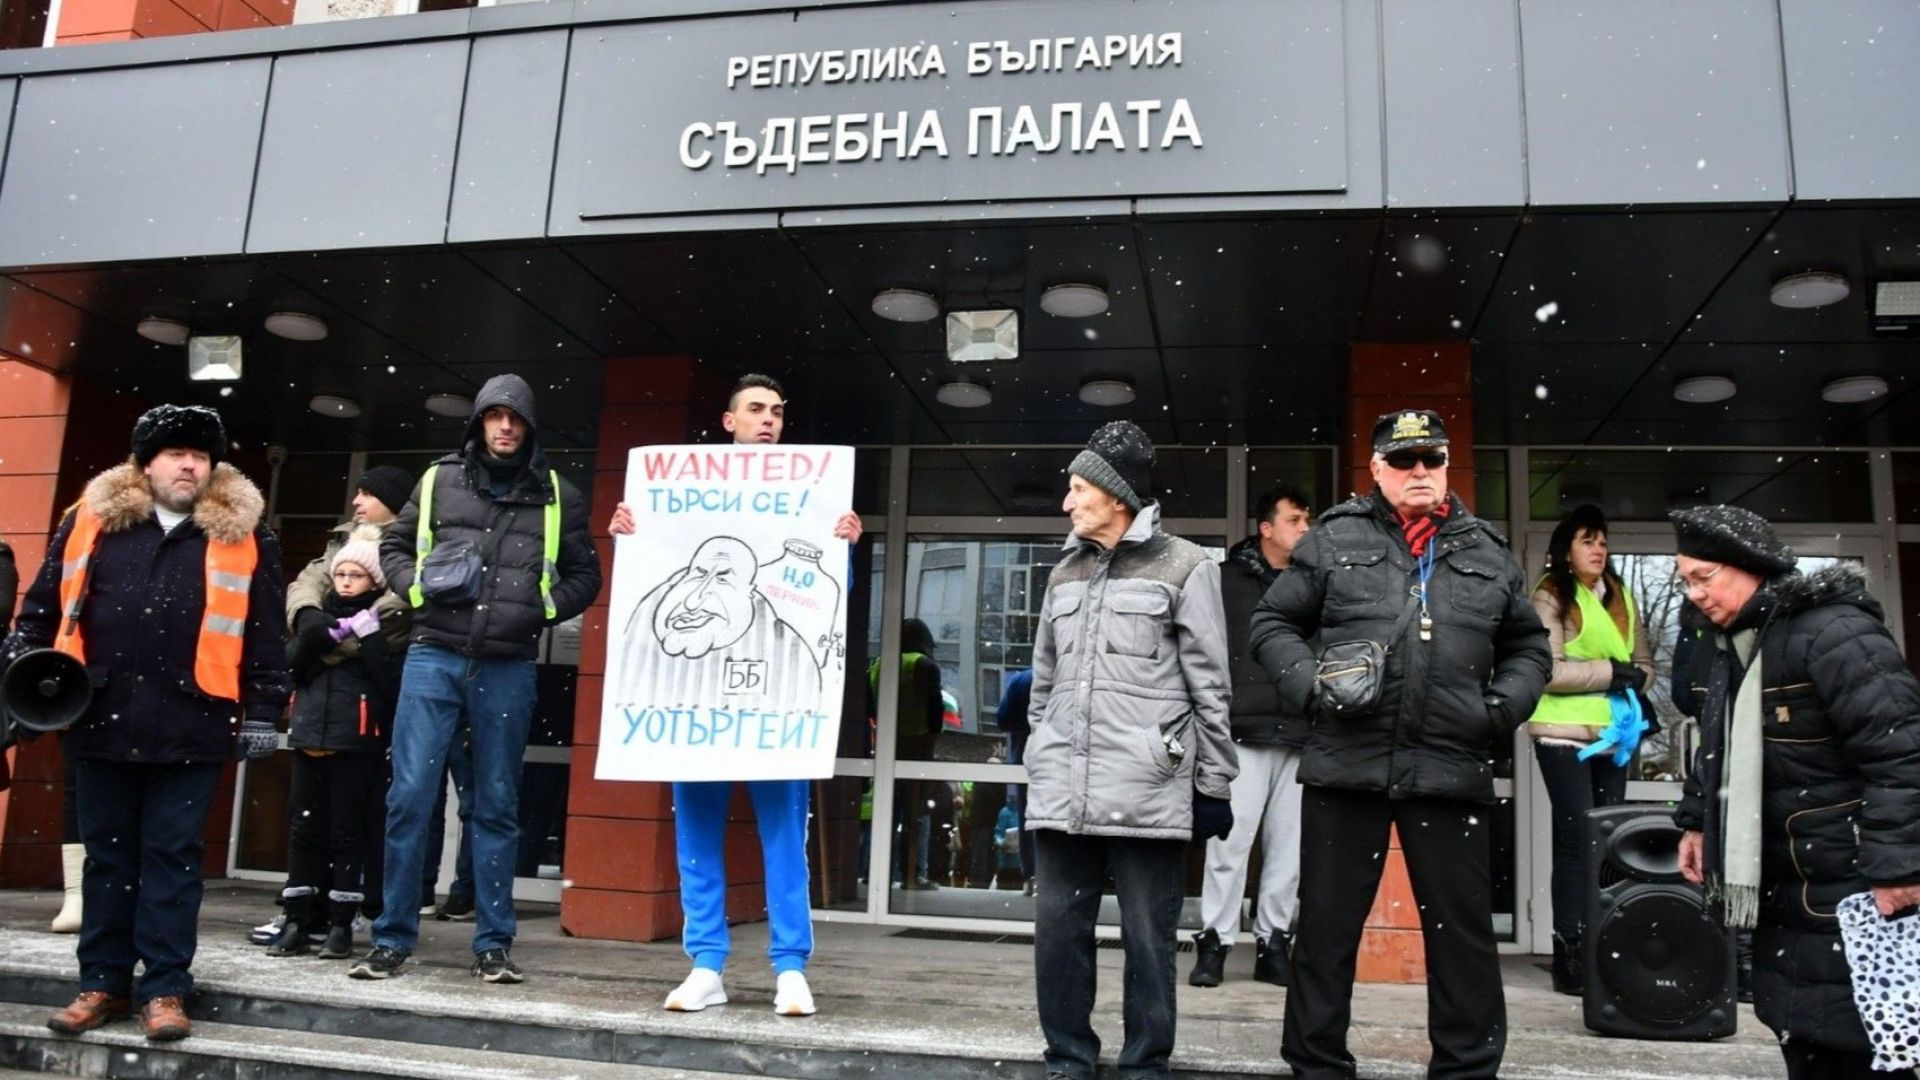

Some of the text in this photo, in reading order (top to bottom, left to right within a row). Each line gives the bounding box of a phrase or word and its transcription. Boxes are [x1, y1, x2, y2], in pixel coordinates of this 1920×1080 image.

[727, 32, 1182, 89] РЕПУБЛИКА БЪЛГАРИЯ
[678, 98, 1203, 174] СЪДЕБНА ПАЛАТА
[644, 450, 831, 485] WANTED!
[648, 488, 742, 513] ТЪРСИ
[728, 663, 760, 689] ББ
